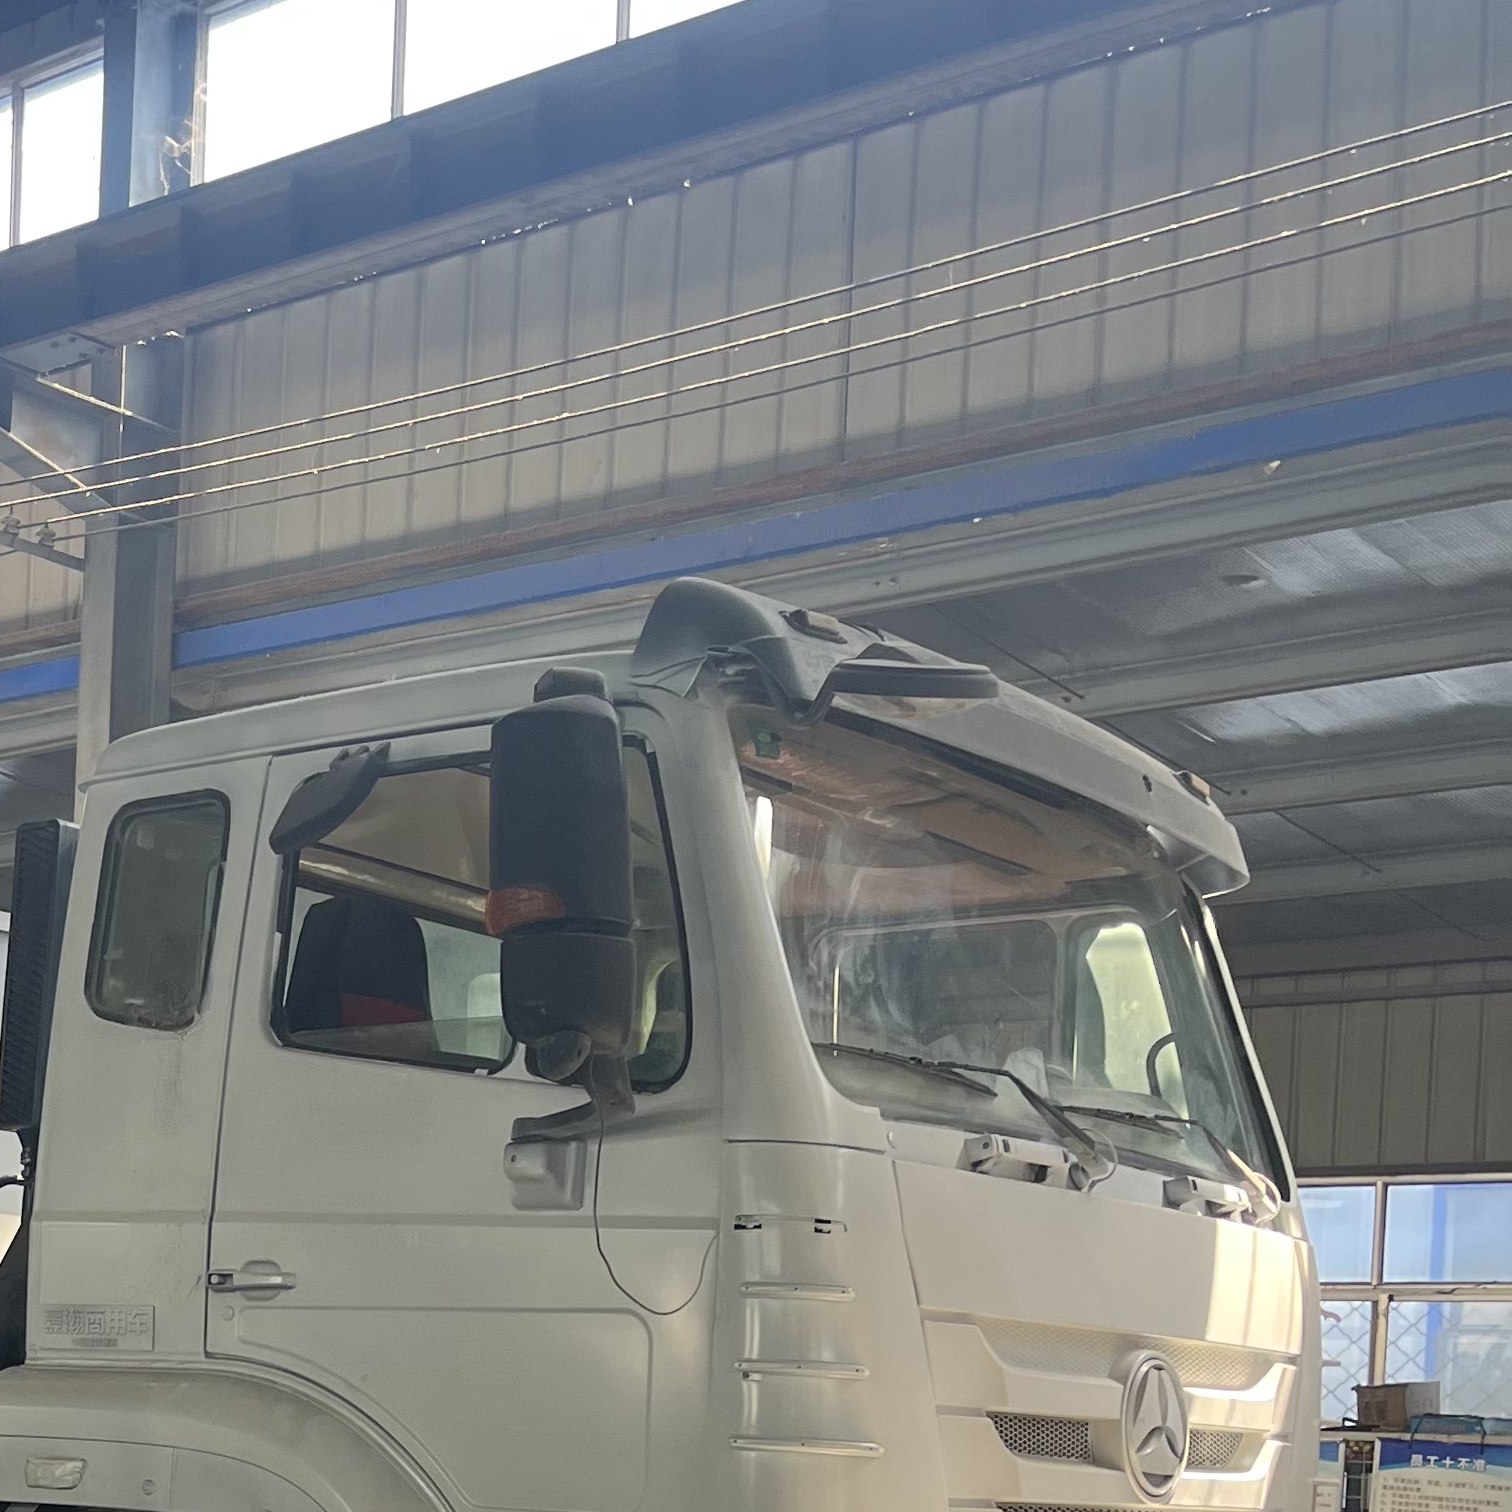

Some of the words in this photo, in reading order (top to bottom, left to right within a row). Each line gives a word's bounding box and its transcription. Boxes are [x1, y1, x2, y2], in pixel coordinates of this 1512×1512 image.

[1410, 1453, 1487, 1472] 员工十不准
